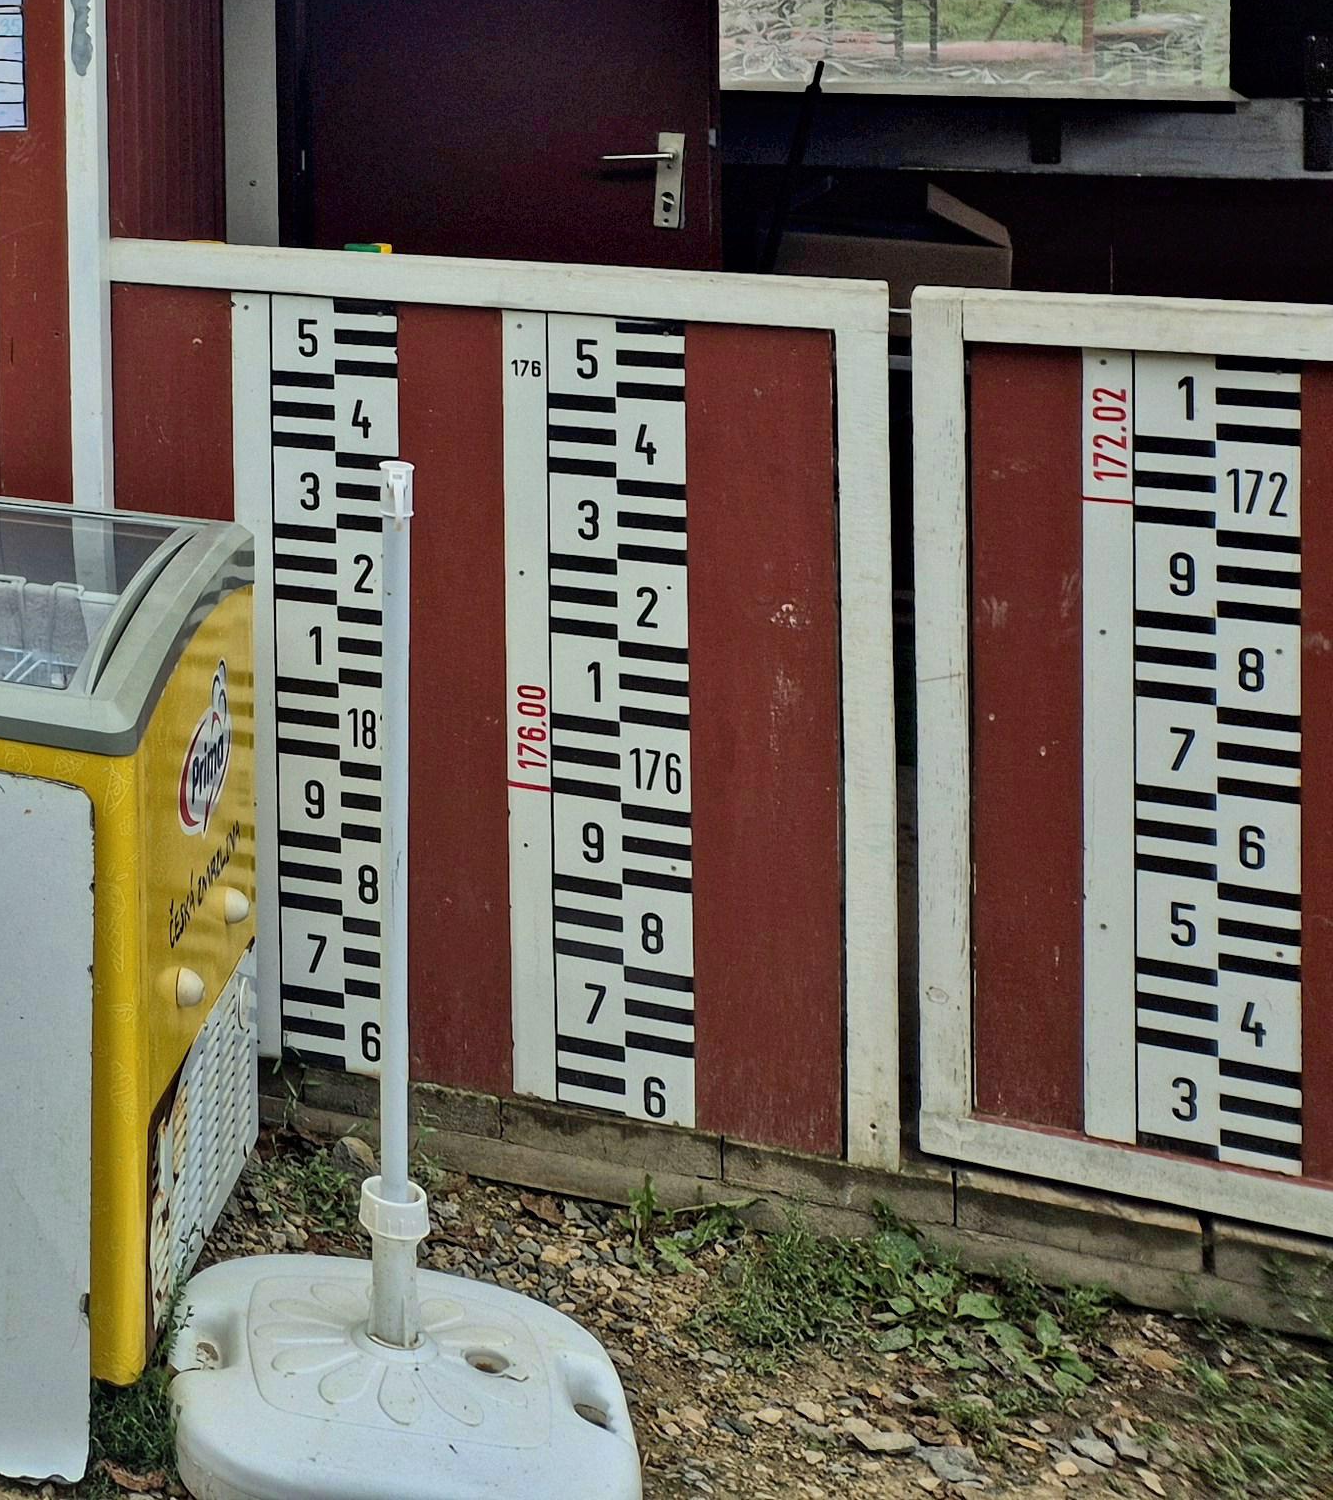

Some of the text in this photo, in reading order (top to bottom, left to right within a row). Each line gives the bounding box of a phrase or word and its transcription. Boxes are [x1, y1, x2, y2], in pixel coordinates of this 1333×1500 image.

[298, 318, 319, 357] 5
[575, 337, 600, 380] 5
[509, 358, 544, 381] 176
[350, 399, 372, 440] 4
[1175, 374, 1195, 423] 1
[632, 423, 659, 467] 4
[1090, 385, 1129, 483] 172.02
[299, 472, 321, 511] 3
[1225, 466, 1290, 519] 172
[576, 499, 601, 541] 3
[353, 554, 374, 595] 2
[1169, 550, 1197, 598] 9
[634, 586, 660, 630] 2
[307, 625, 325, 666] 1
[586, 660, 602, 703] 1
[1237, 646, 1266, 694] 8
[514, 682, 549, 771] 176.00
[1169, 724, 1196, 773] 7
[190, 731, 224, 805] Prima
[628, 746, 683, 797] 176
[304, 780, 325, 820] 9
[581, 820, 606, 864] 9
[1237, 824, 1266, 871] 6
[358, 863, 380, 903] 8
[639, 911, 665, 955] 8
[1169, 901, 1197, 949] 5
[306, 933, 329, 974] 7
[583, 982, 608, 1025] 7
[1238, 1000, 1268, 1048] 4
[360, 1019, 382, 1063] 6
[642, 1075, 668, 1119] 6
[1170, 1076, 1197, 1123] 3
